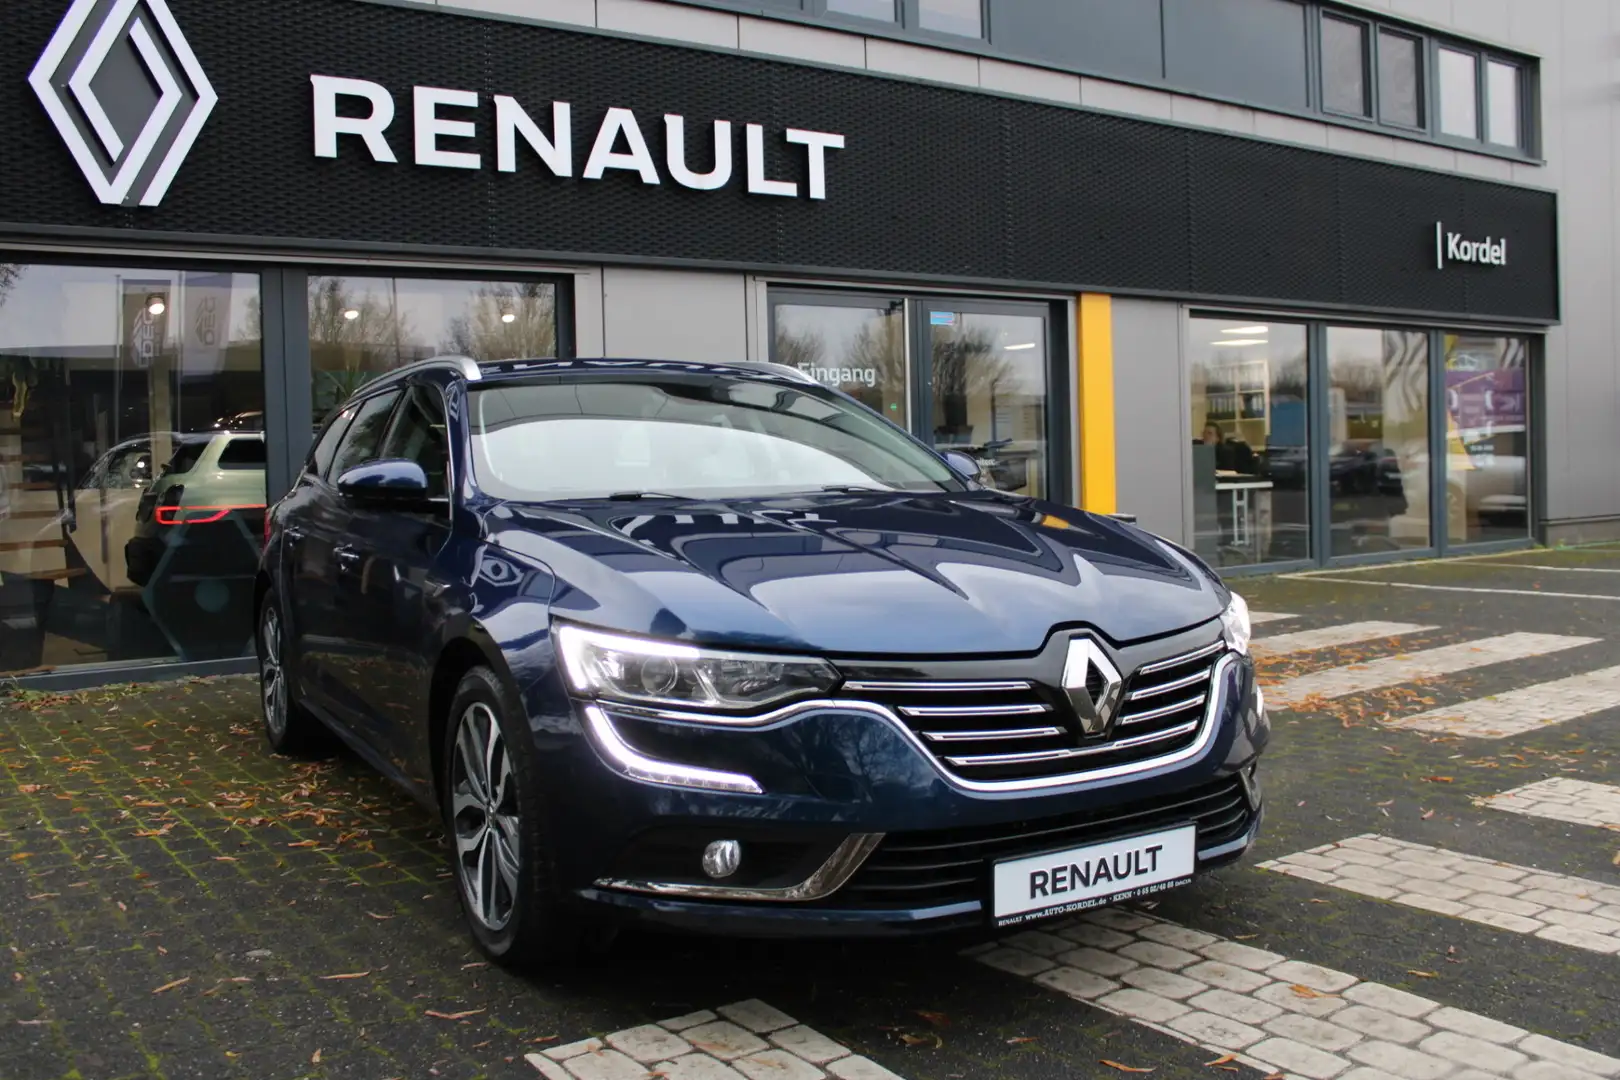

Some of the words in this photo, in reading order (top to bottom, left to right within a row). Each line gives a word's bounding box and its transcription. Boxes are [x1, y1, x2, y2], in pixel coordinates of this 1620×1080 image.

[310, 73, 846, 200] RENAULT
[1446, 232, 1507, 266] Kordel
[797, 361, 876, 388] Eingang
[1029, 844, 1163, 900] RENAULT
[997, 916, 1023, 927] RENAULT
